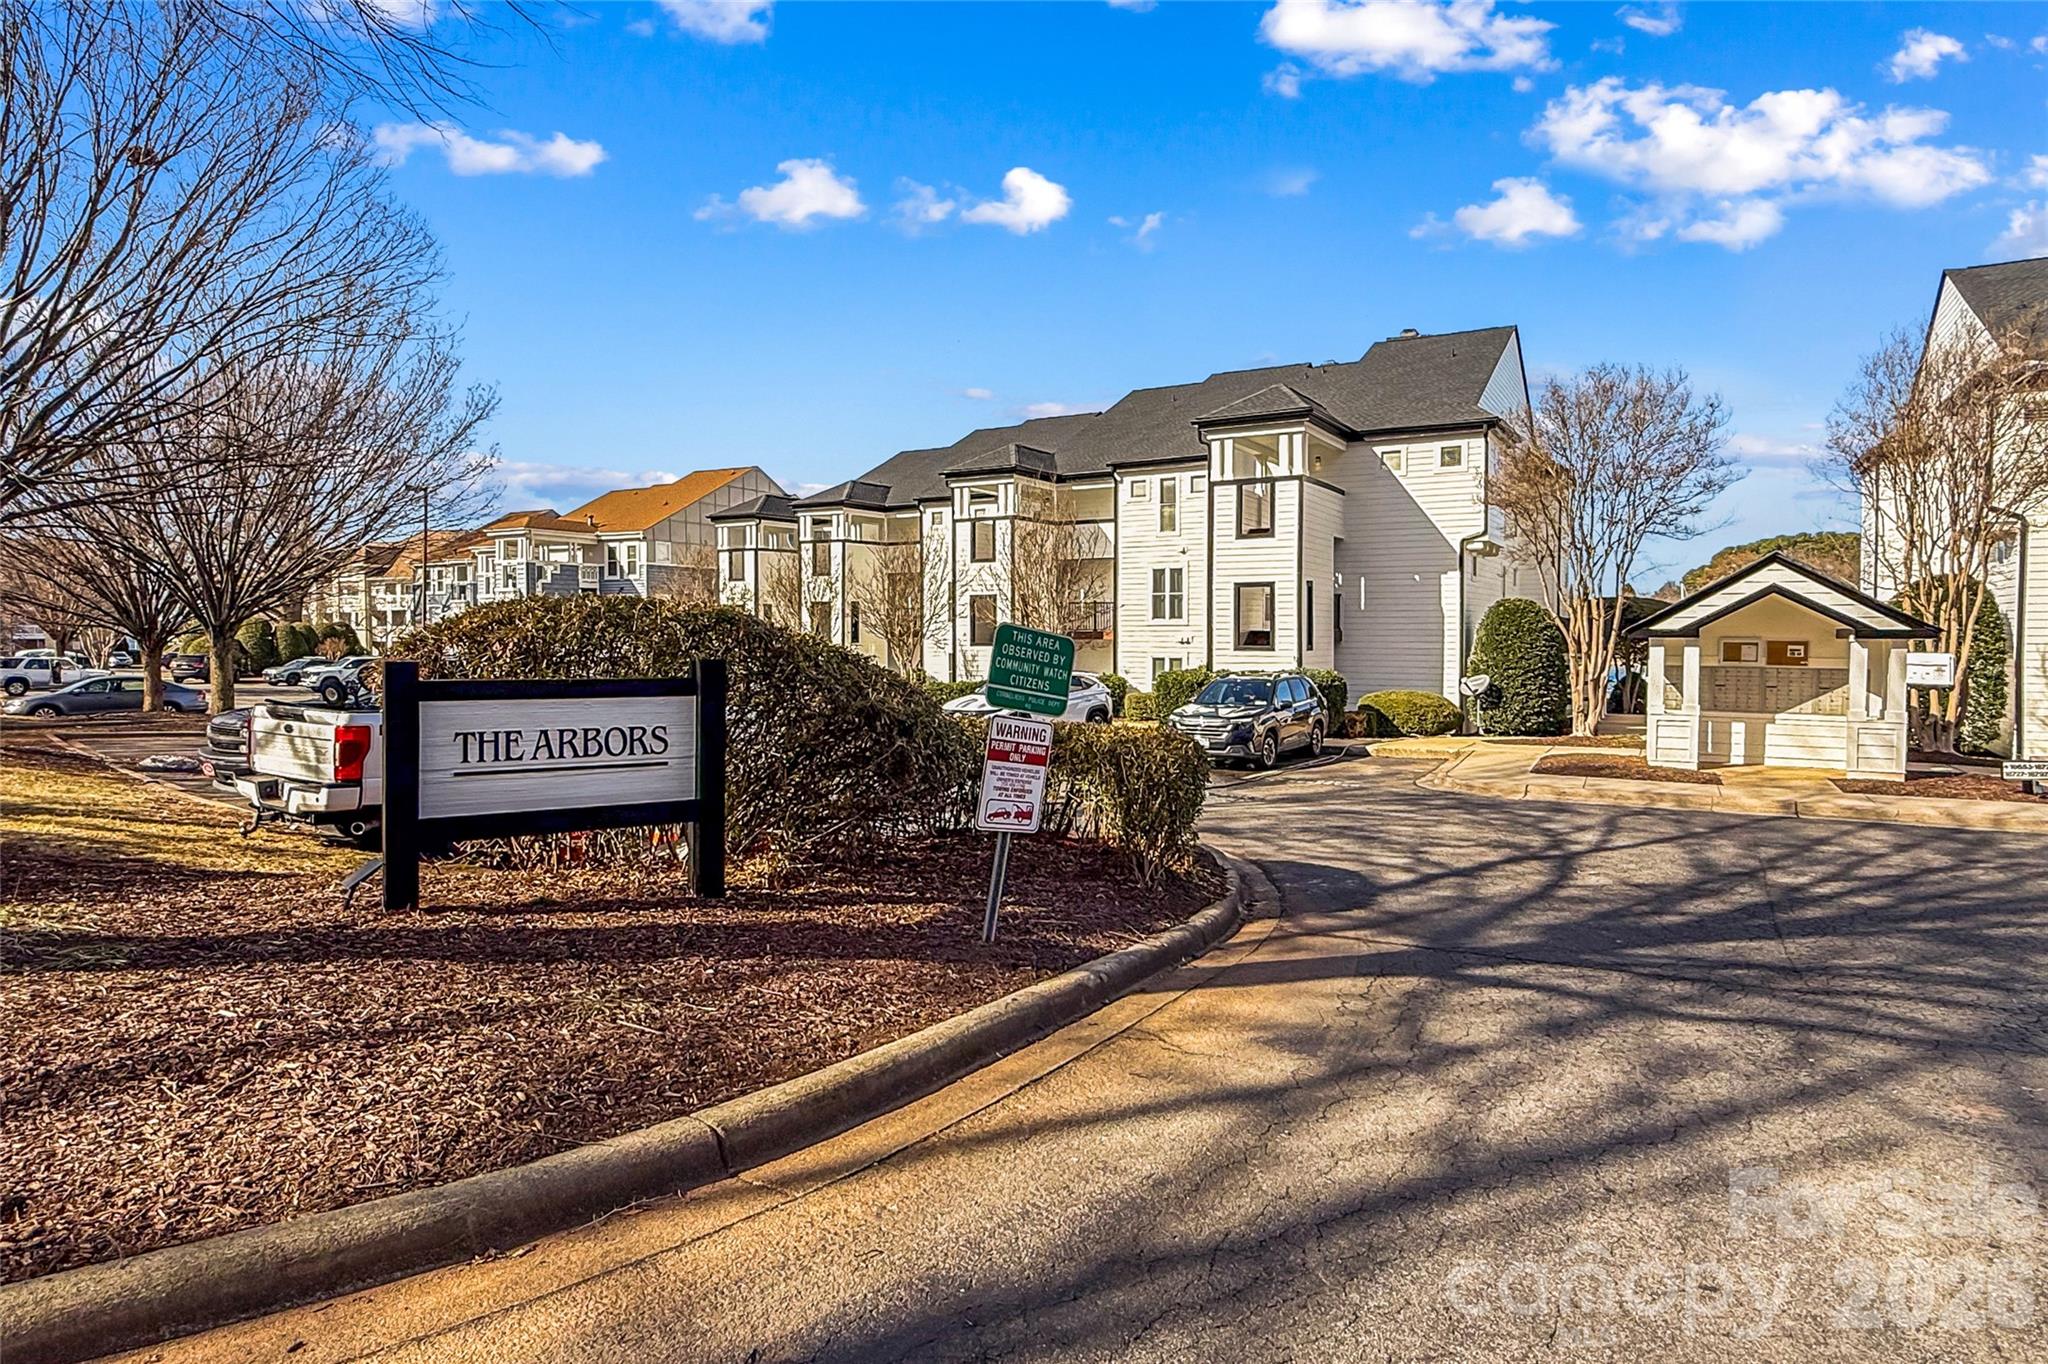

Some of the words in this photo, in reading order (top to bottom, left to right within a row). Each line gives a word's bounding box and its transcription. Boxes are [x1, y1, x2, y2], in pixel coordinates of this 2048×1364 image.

[1012, 630, 1033, 645] THIS
[1035, 636, 1060, 651] AREA
[1001, 643, 1050, 663] OBSERVED
[1052, 653, 1066, 666] BY
[995, 656, 1040, 675] COMMUNITY
[1043, 667, 1068, 681] WATCH
[1009, 674, 1050, 691] CITIZENS
[995, 722, 1047, 743] WARNING
[453, 729, 526, 764] THE
[530, 725, 669, 761] ARBORS
[990, 741, 1016, 752] PERMIT
[1018, 745, 1047, 757] PARKING
[1008, 752, 1027, 763] ONLY
